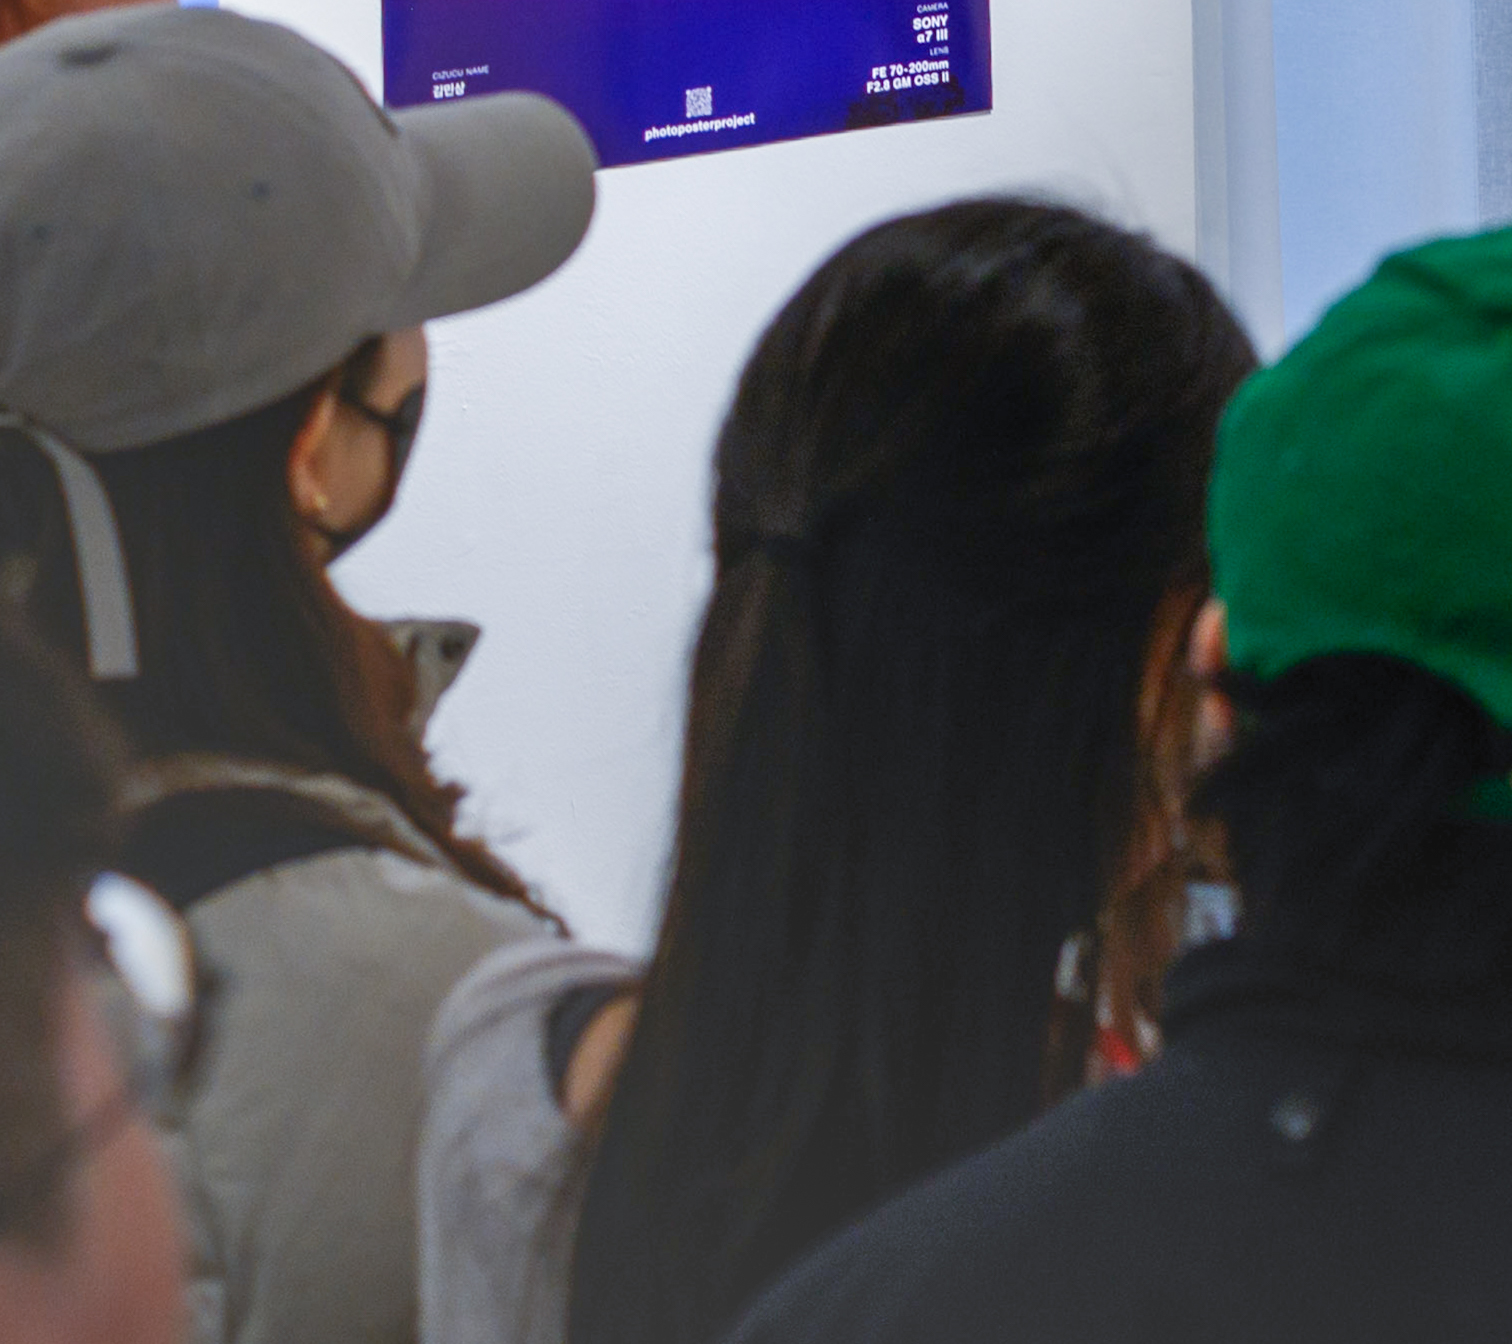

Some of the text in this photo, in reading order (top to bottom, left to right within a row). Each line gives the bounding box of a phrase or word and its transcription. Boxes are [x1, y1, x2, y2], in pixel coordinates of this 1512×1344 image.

[917, 2, 948, 13] CAMERA
[913, 14, 949, 31] SONY
[936, 28, 948, 41] III
[929, 45, 949, 56] LENS
[465, 64, 489, 76] NAME
[872, 66, 887, 79] FE
[867, 70, 949, 94] F2.8 GM OSS II
[645, 112, 755, 142] photoposterproject
